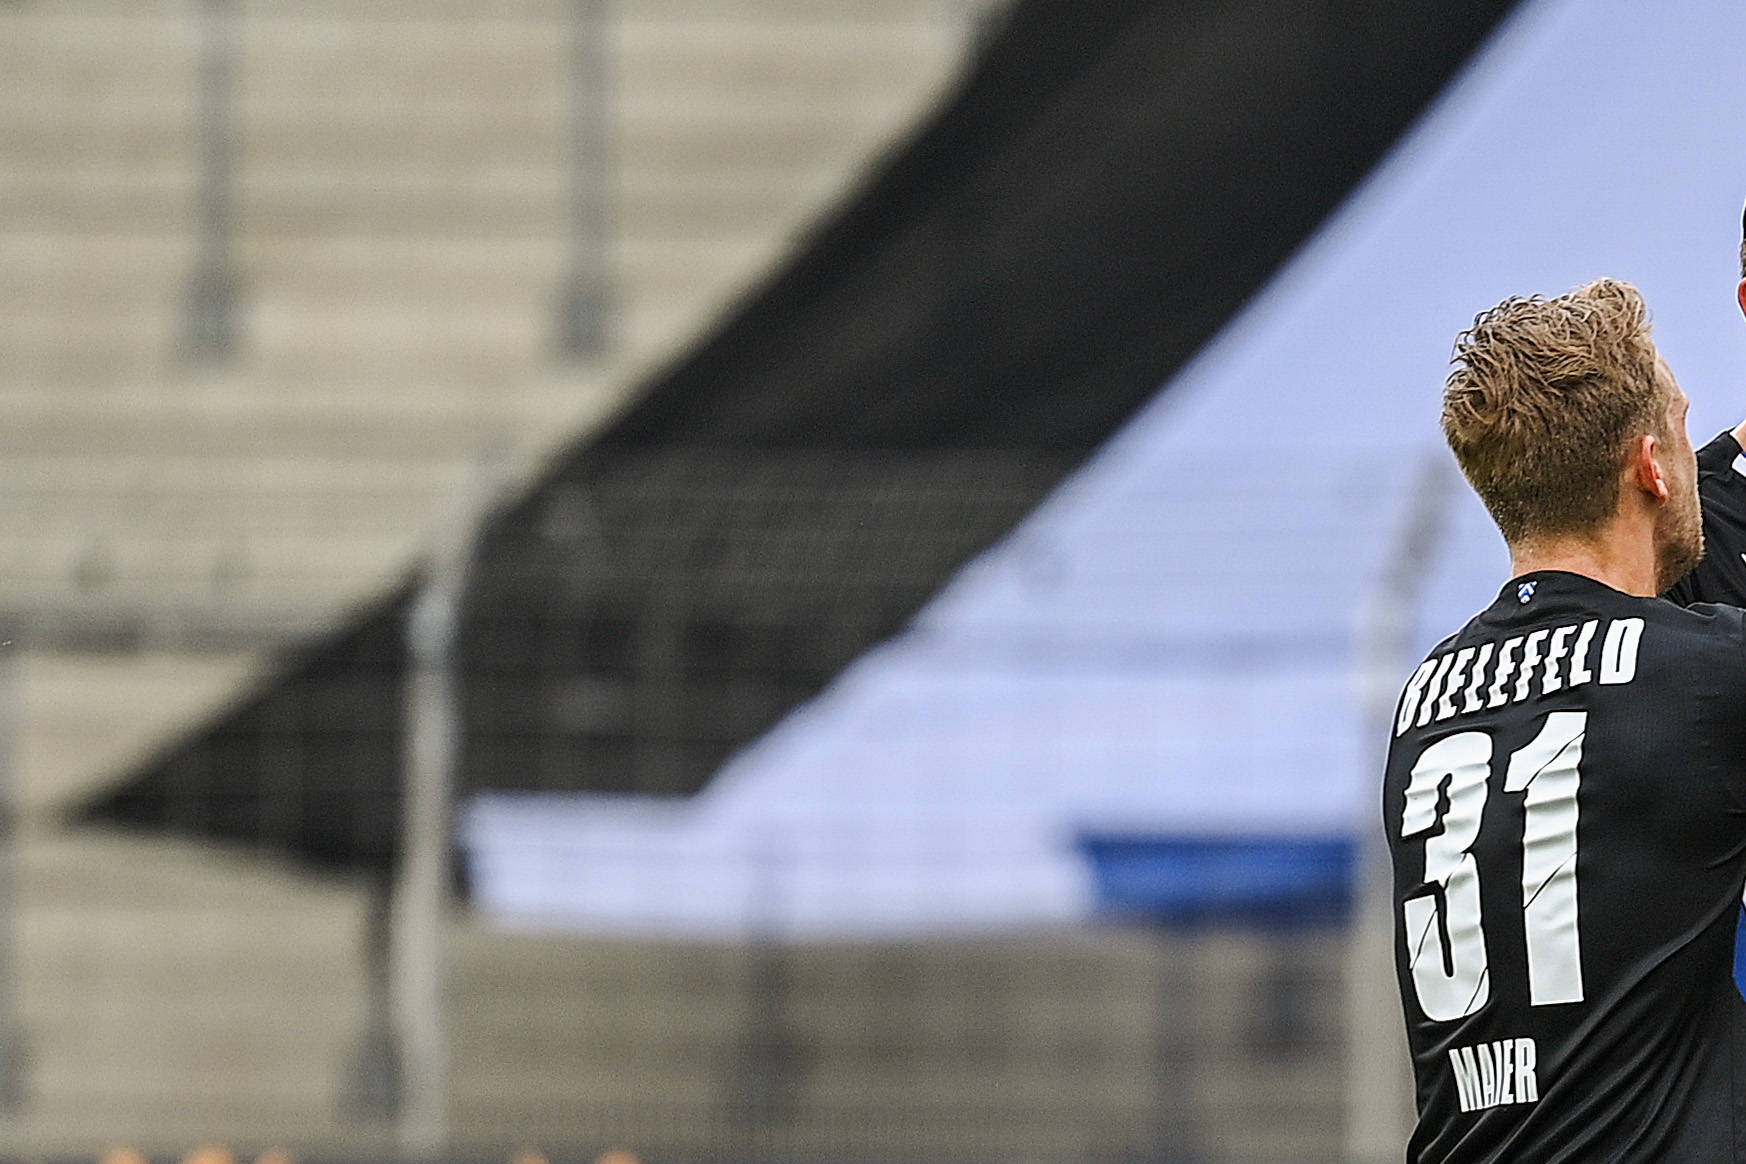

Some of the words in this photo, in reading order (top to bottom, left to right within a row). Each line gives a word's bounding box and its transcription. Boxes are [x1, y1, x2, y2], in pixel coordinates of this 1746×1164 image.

[1396, 617, 1646, 738] BIELEFELD
[1400, 711, 1589, 1023] 31
[1448, 1037, 1539, 1113] MAIER
